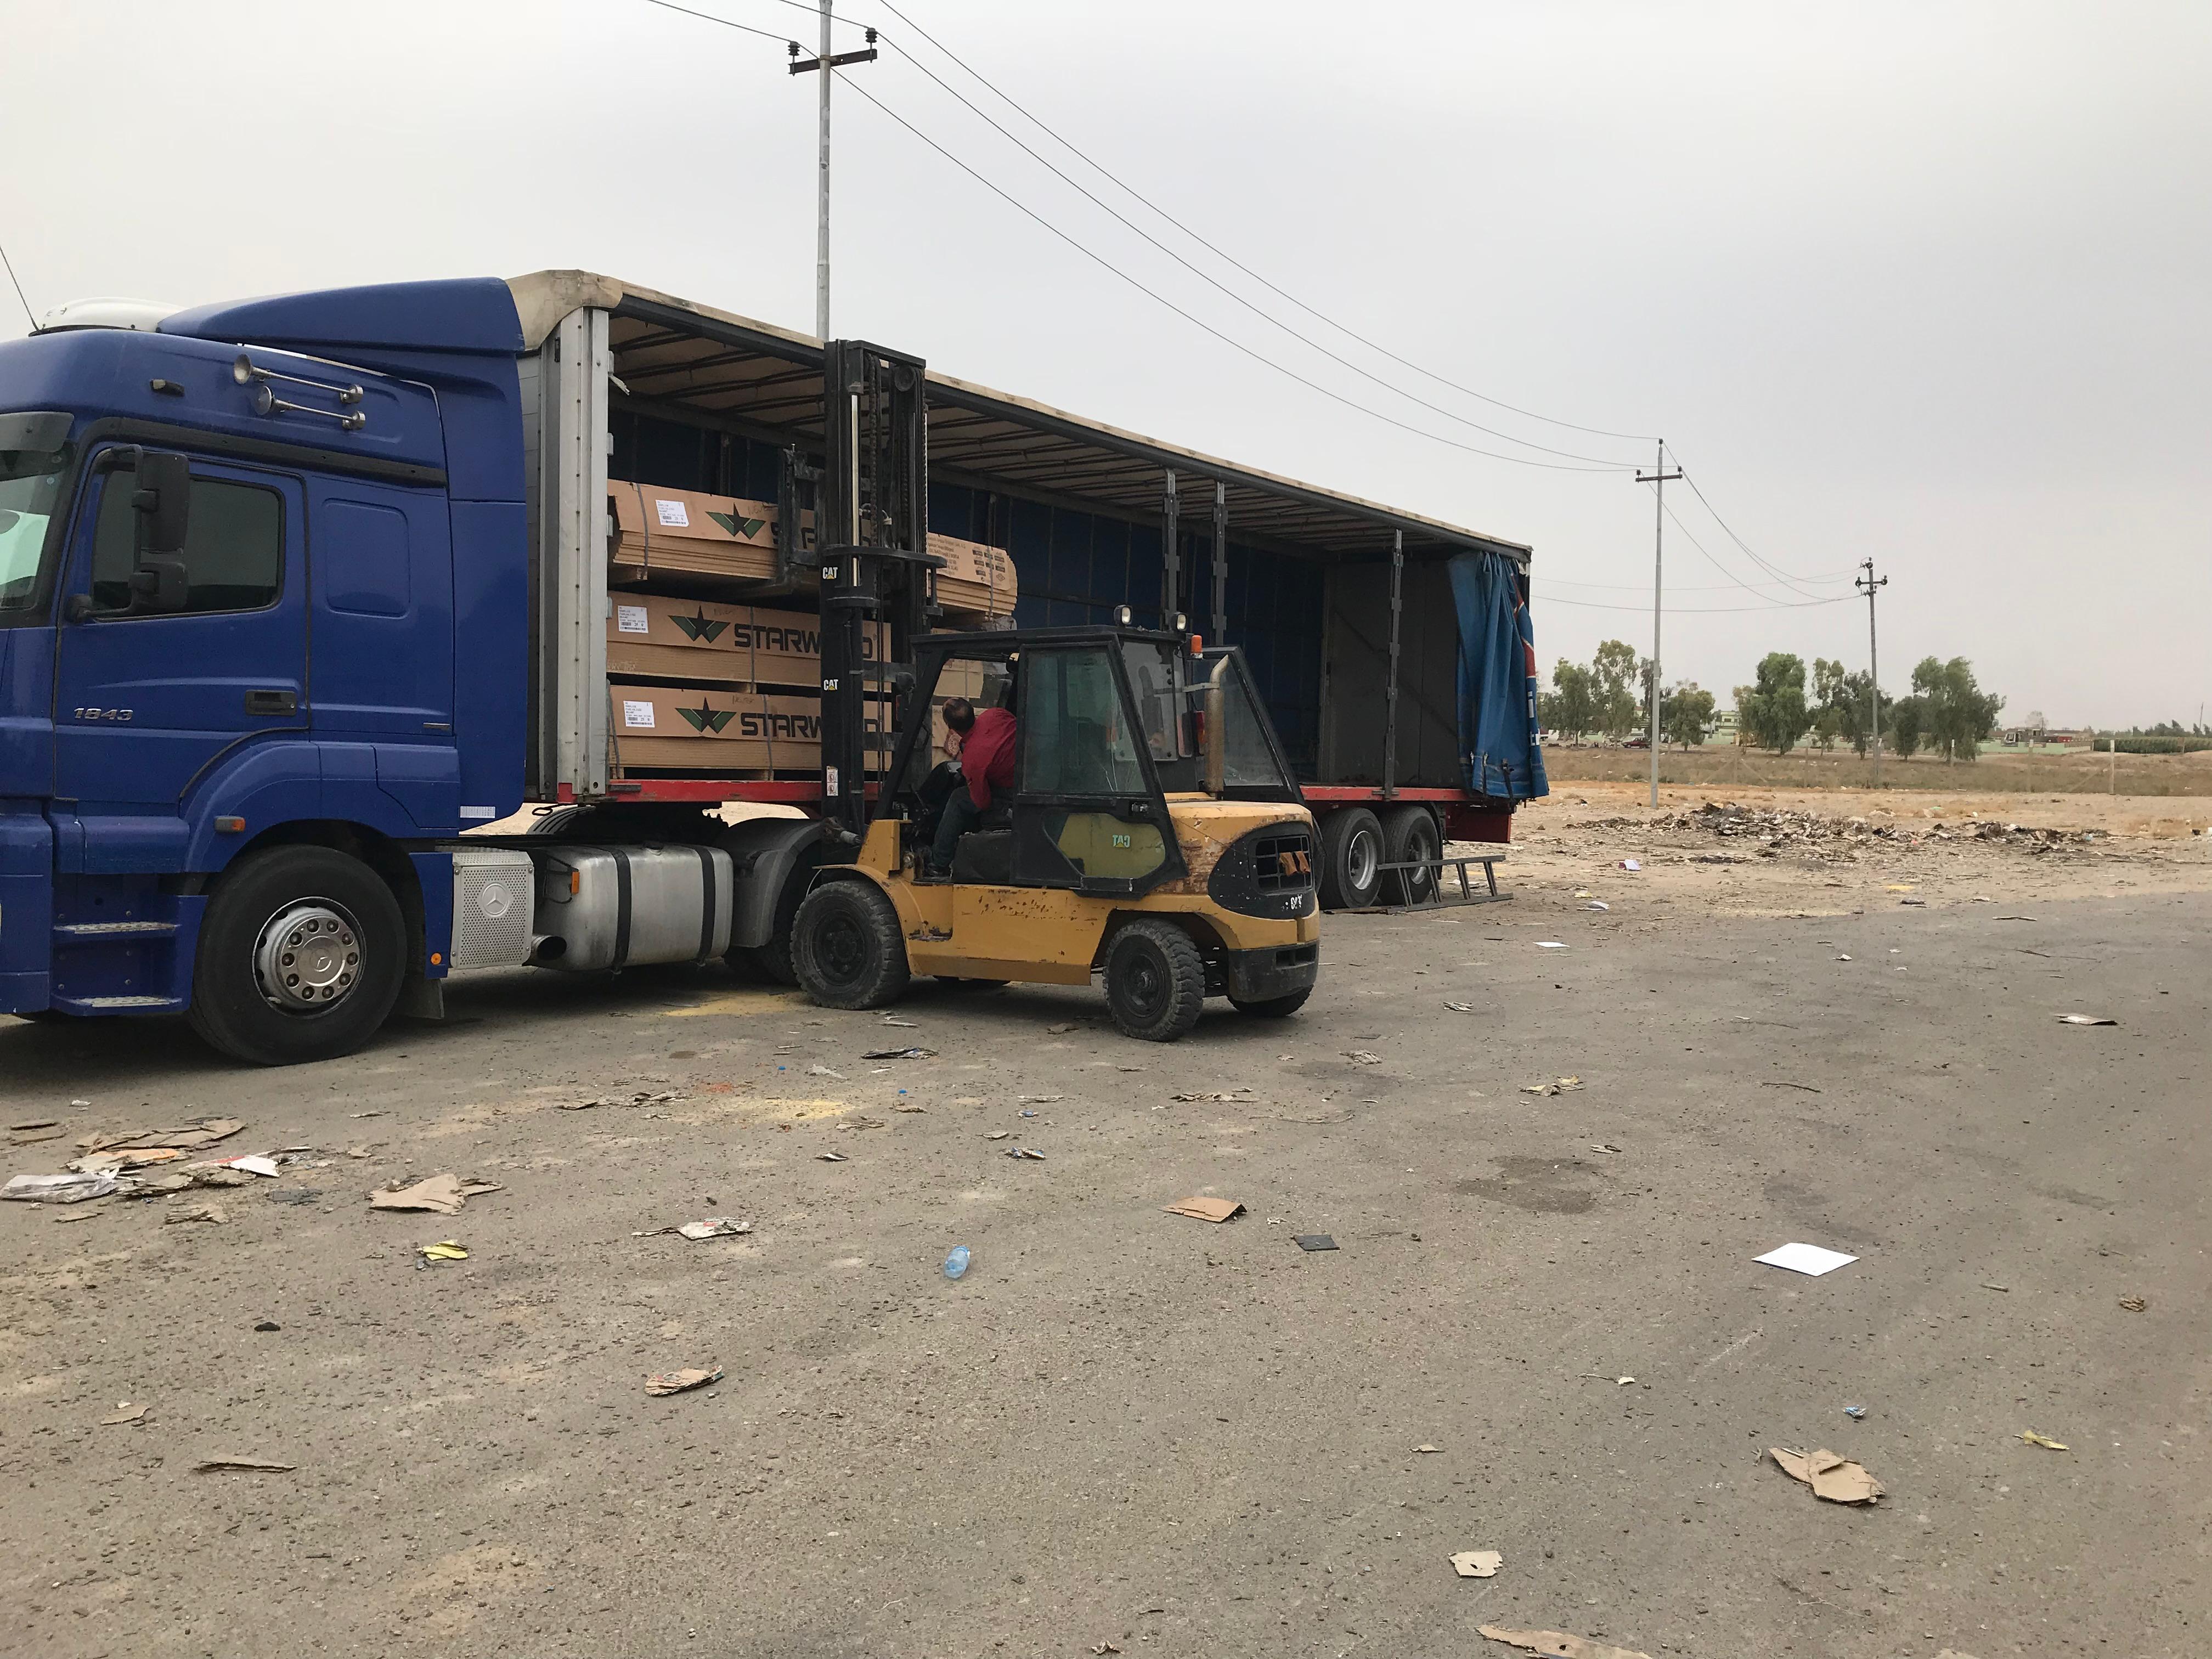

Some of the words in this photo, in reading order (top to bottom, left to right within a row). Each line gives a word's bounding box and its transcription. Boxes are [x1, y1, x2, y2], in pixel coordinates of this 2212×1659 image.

[822, 567, 838, 579] CAT
[735, 623, 873, 659] STARWD
[823, 679, 839, 691] CAT
[74, 708, 134, 721] 1843
[741, 713, 878, 738] STARWD
